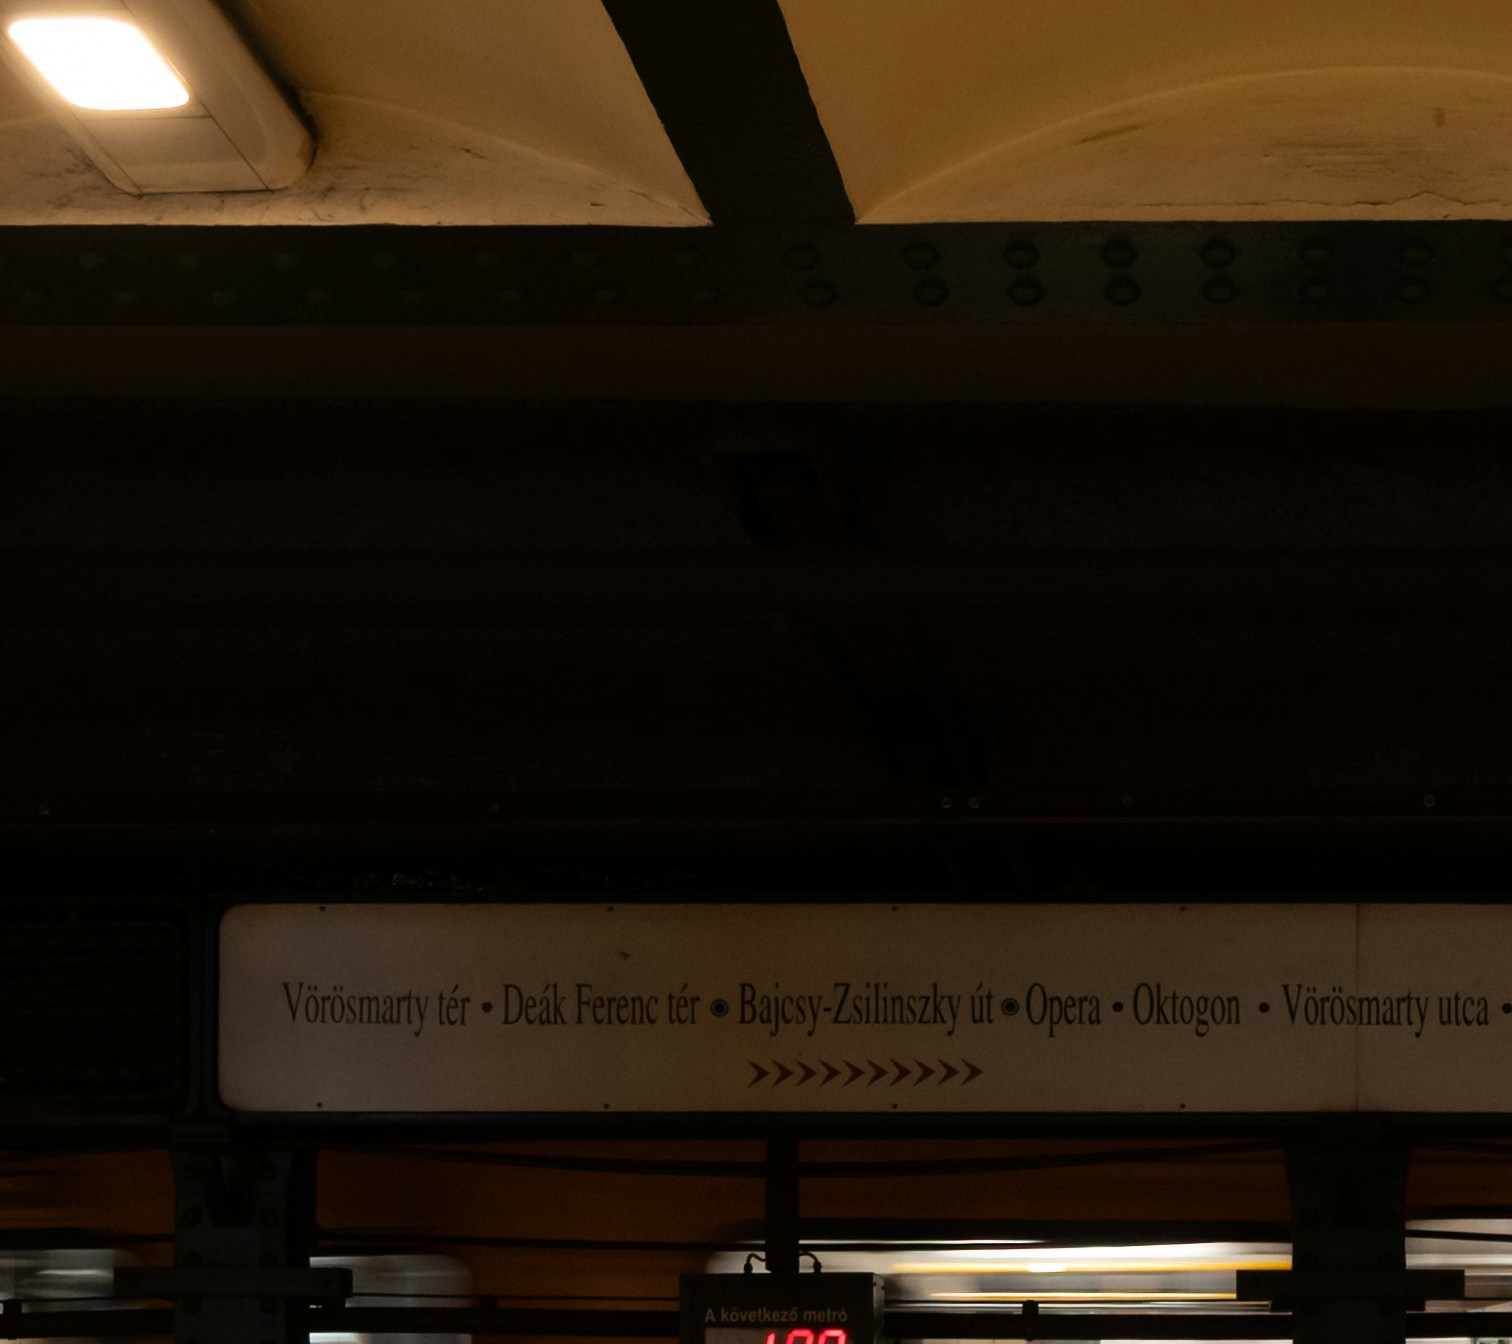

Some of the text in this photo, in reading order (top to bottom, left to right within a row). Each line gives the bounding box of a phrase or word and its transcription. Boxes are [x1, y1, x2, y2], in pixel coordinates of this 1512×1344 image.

[281, 982, 429, 1037] Vörösmarty
[437, 983, 471, 1026] tér
[502, 983, 567, 1025] Deák
[575, 983, 658, 1025] Ferenc
[667, 982, 700, 1025] tér
[738, 981, 961, 1038] Bajcsy-Zsilinszky
[970, 983, 994, 1027] út
[1025, 984, 1101, 1038] Opera
[1132, 982, 1240, 1037] Oktogon
[1281, 983, 1429, 1038] Vörösmarty
[1438, 991, 1489, 1026] utca
[705, 1306, 848, 1323] A következő metró
